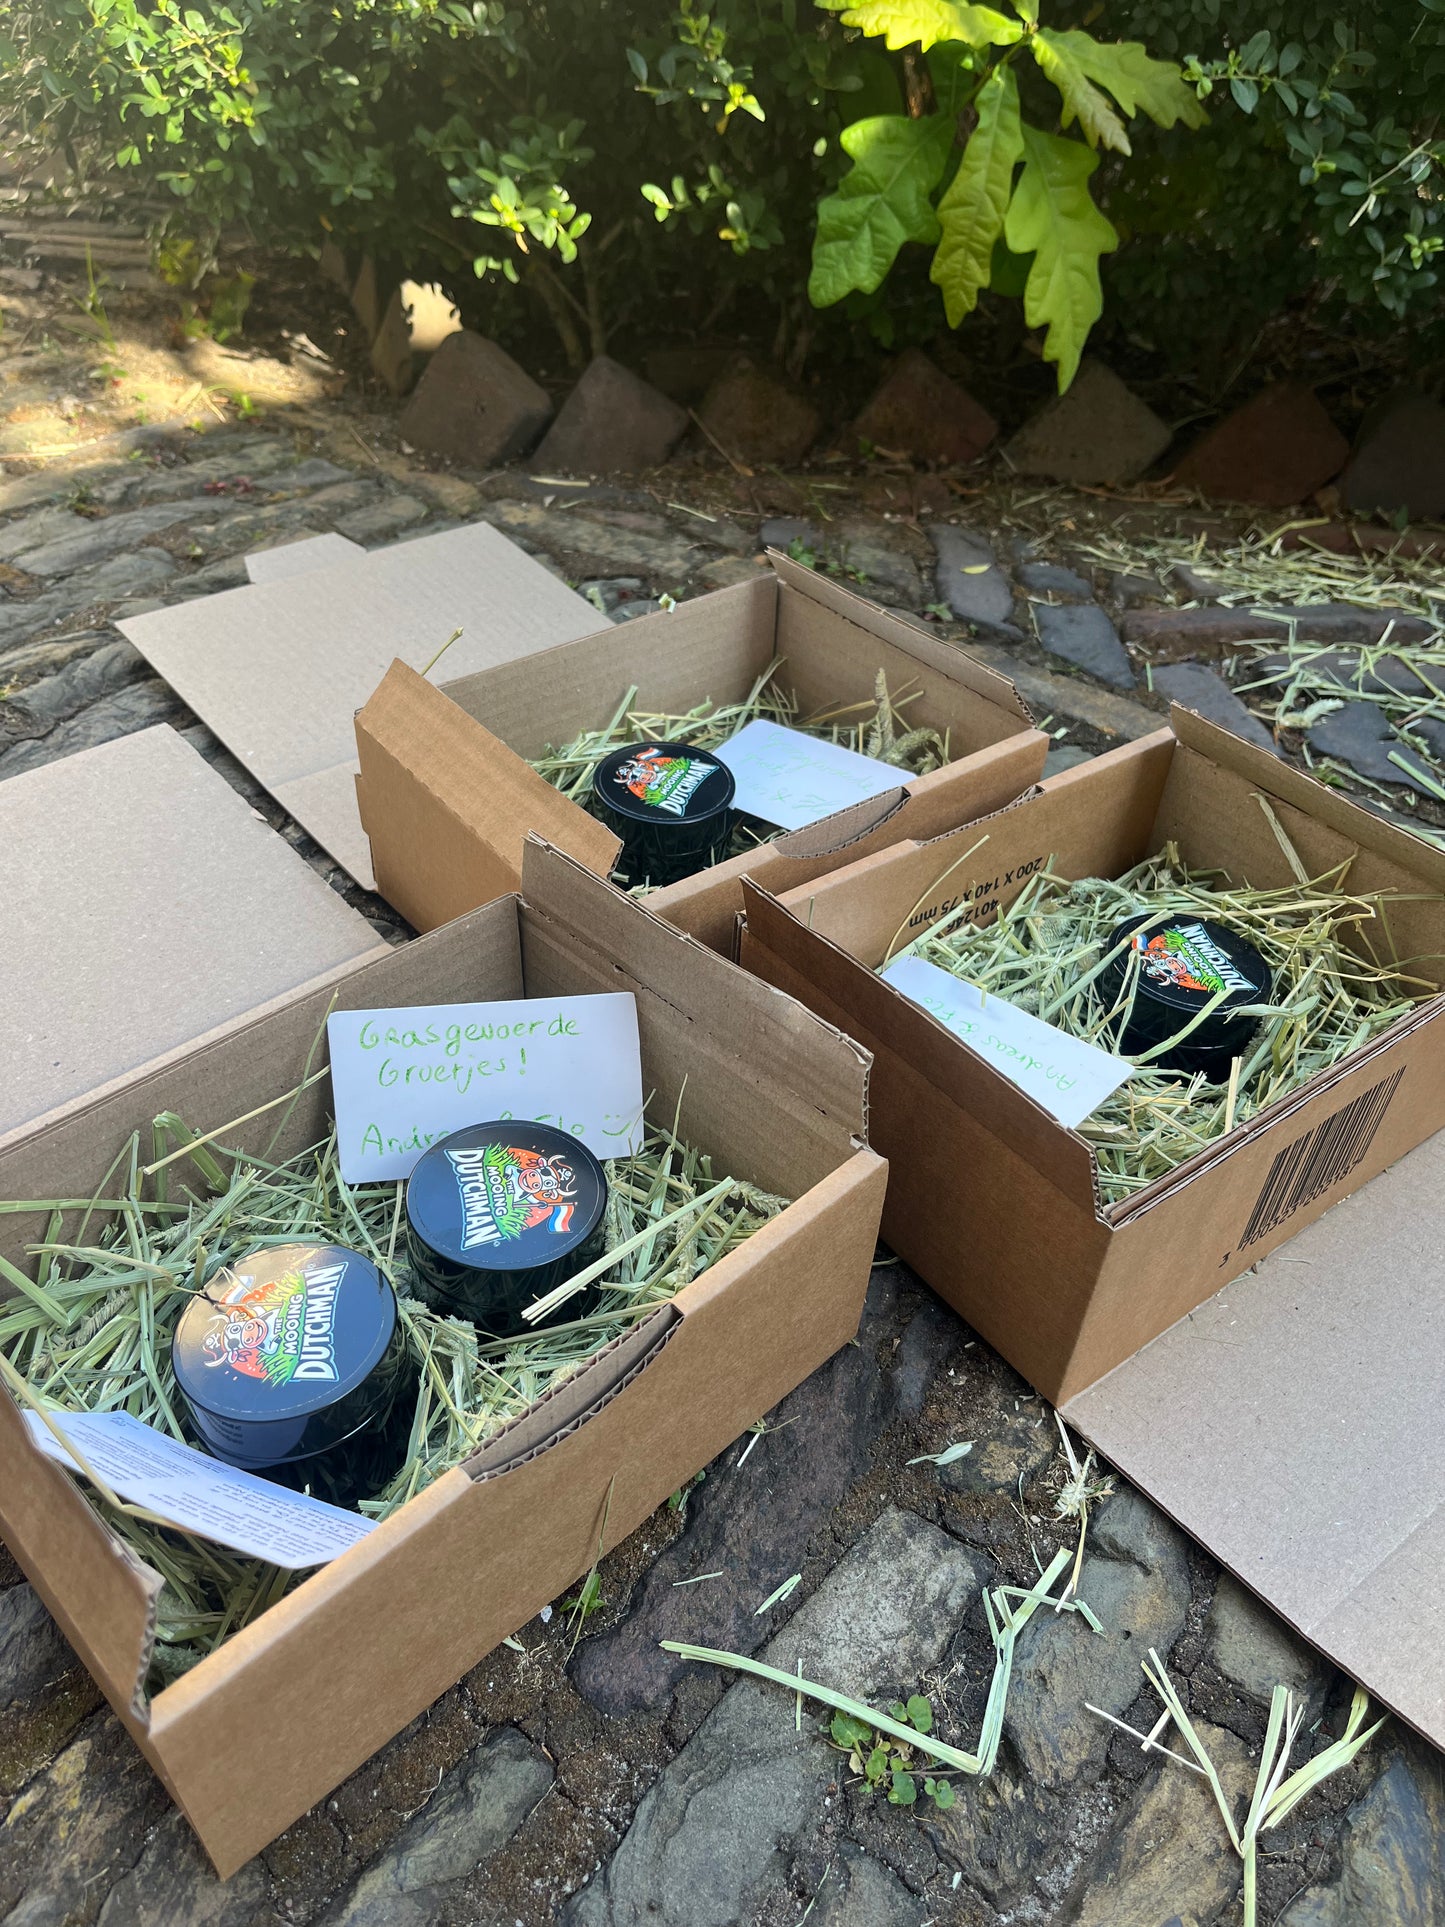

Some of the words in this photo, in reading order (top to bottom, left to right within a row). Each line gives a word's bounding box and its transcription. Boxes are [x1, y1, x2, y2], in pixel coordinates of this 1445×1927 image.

[658, 761, 718, 817] DUTCHMAN
[661, 769, 685, 795] MOOING
[1017, 857, 1043, 880] 200
[975, 877, 999, 899] 140
[909, 906, 938, 927] mm
[940, 896, 958, 916] 75
[1179, 923, 1257, 990] DUTCHMAN
[1182, 942, 1216, 976] MOOING
[923, 997, 955, 1021] Flo
[981, 1035, 1077, 1091] Andreas
[445, 1149, 502, 1249] DUTCHMAN
[487, 1165, 507, 1217] MOOING
[506, 1181, 515, 1194] THE
[1218, 1252, 1231, 1269] 3
[1241, 1204, 1297, 1251] 700323
[275, 1318, 284, 1333] THE
[284, 1294, 304, 1355] MOOING
[292, 1263, 346, 1380] DUTCHMAN
